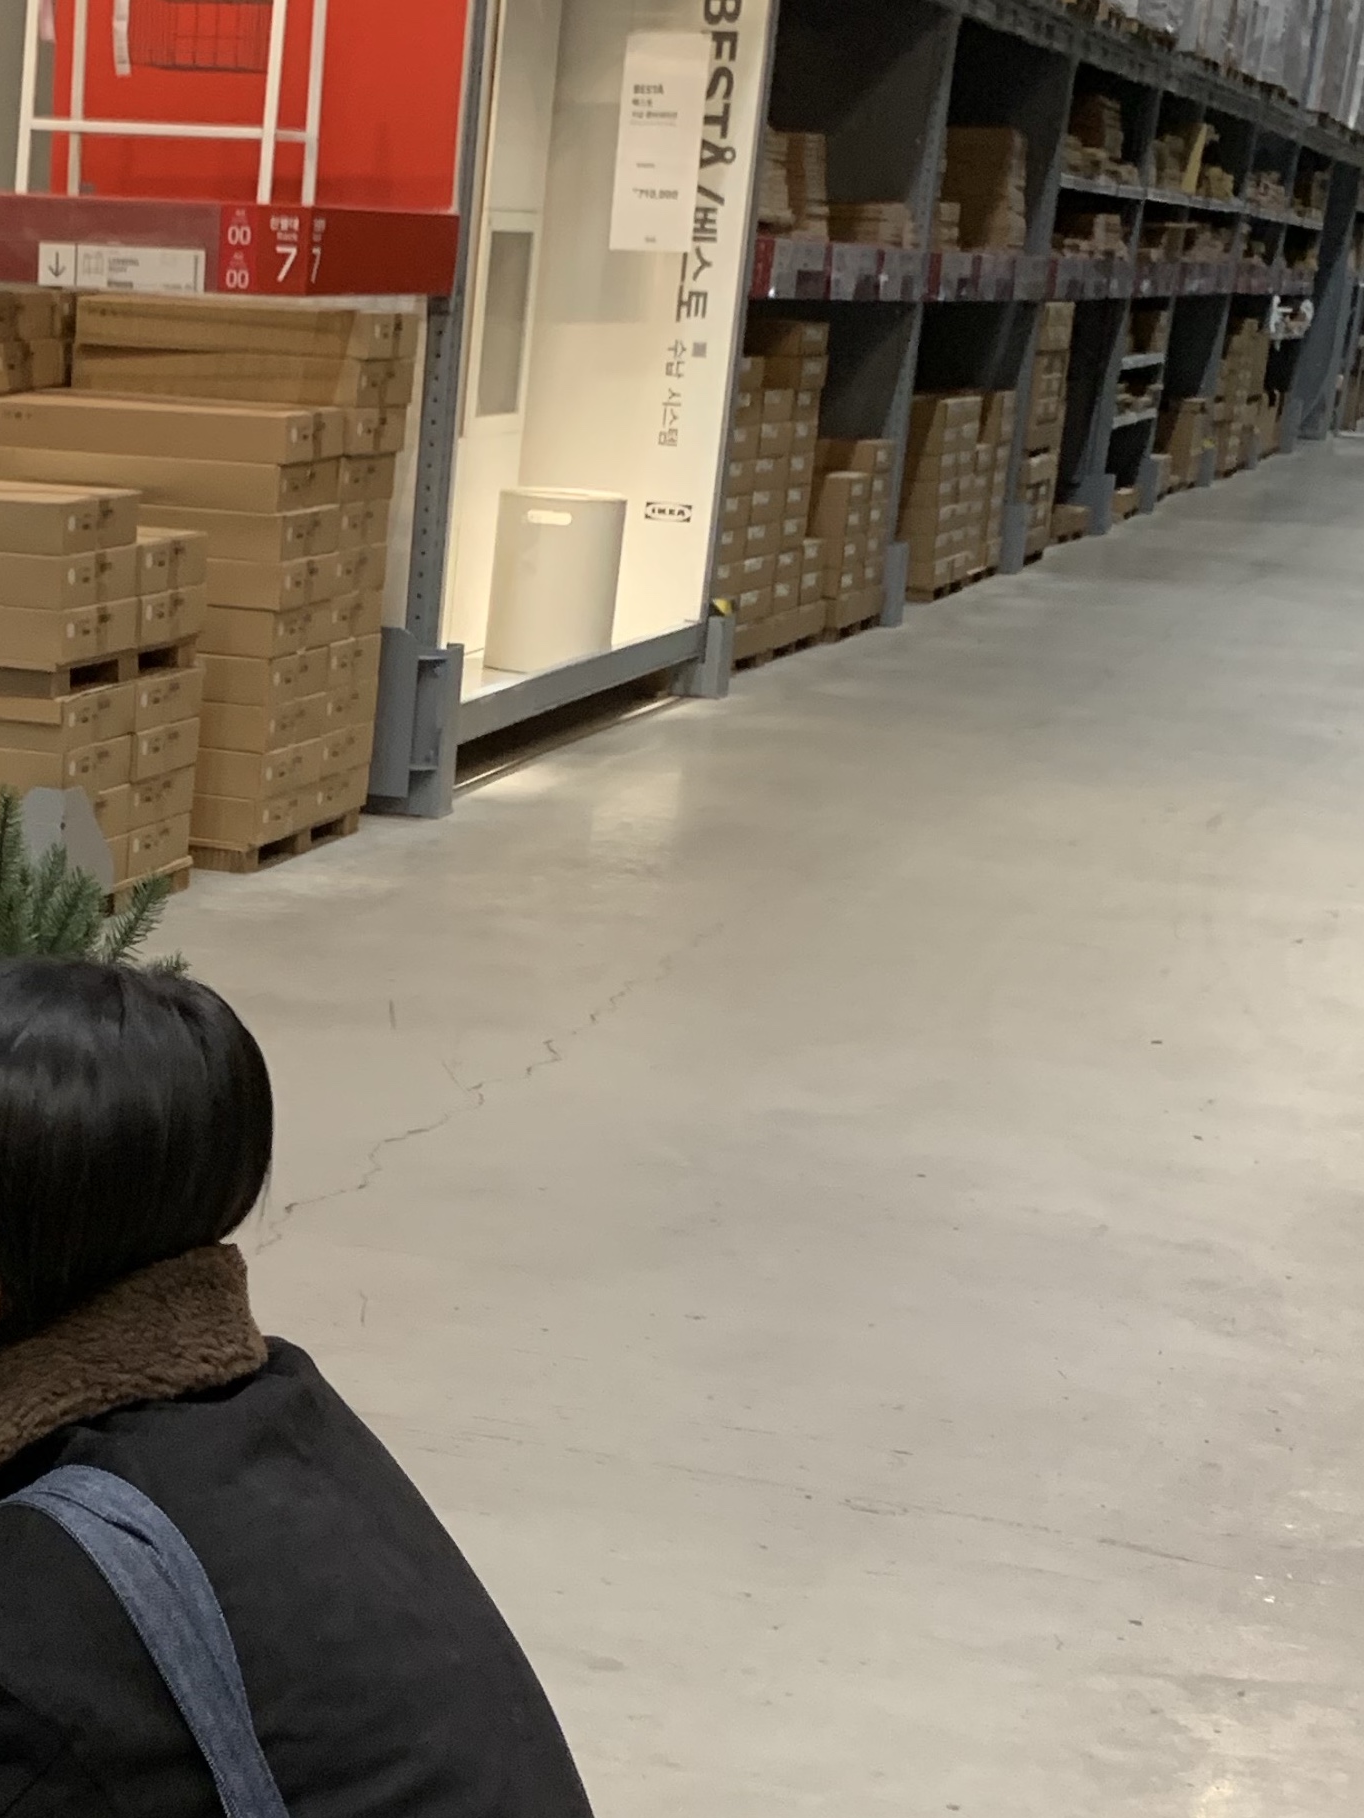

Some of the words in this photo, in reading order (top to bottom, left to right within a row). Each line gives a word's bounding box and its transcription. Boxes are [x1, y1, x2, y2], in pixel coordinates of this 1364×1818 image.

[228, 226, 251, 246] 00
[226, 269, 249, 289] 00
[276, 246, 297, 283] 7
[665, 339, 687, 379] 수납
[658, 387, 681, 447] 시스템
